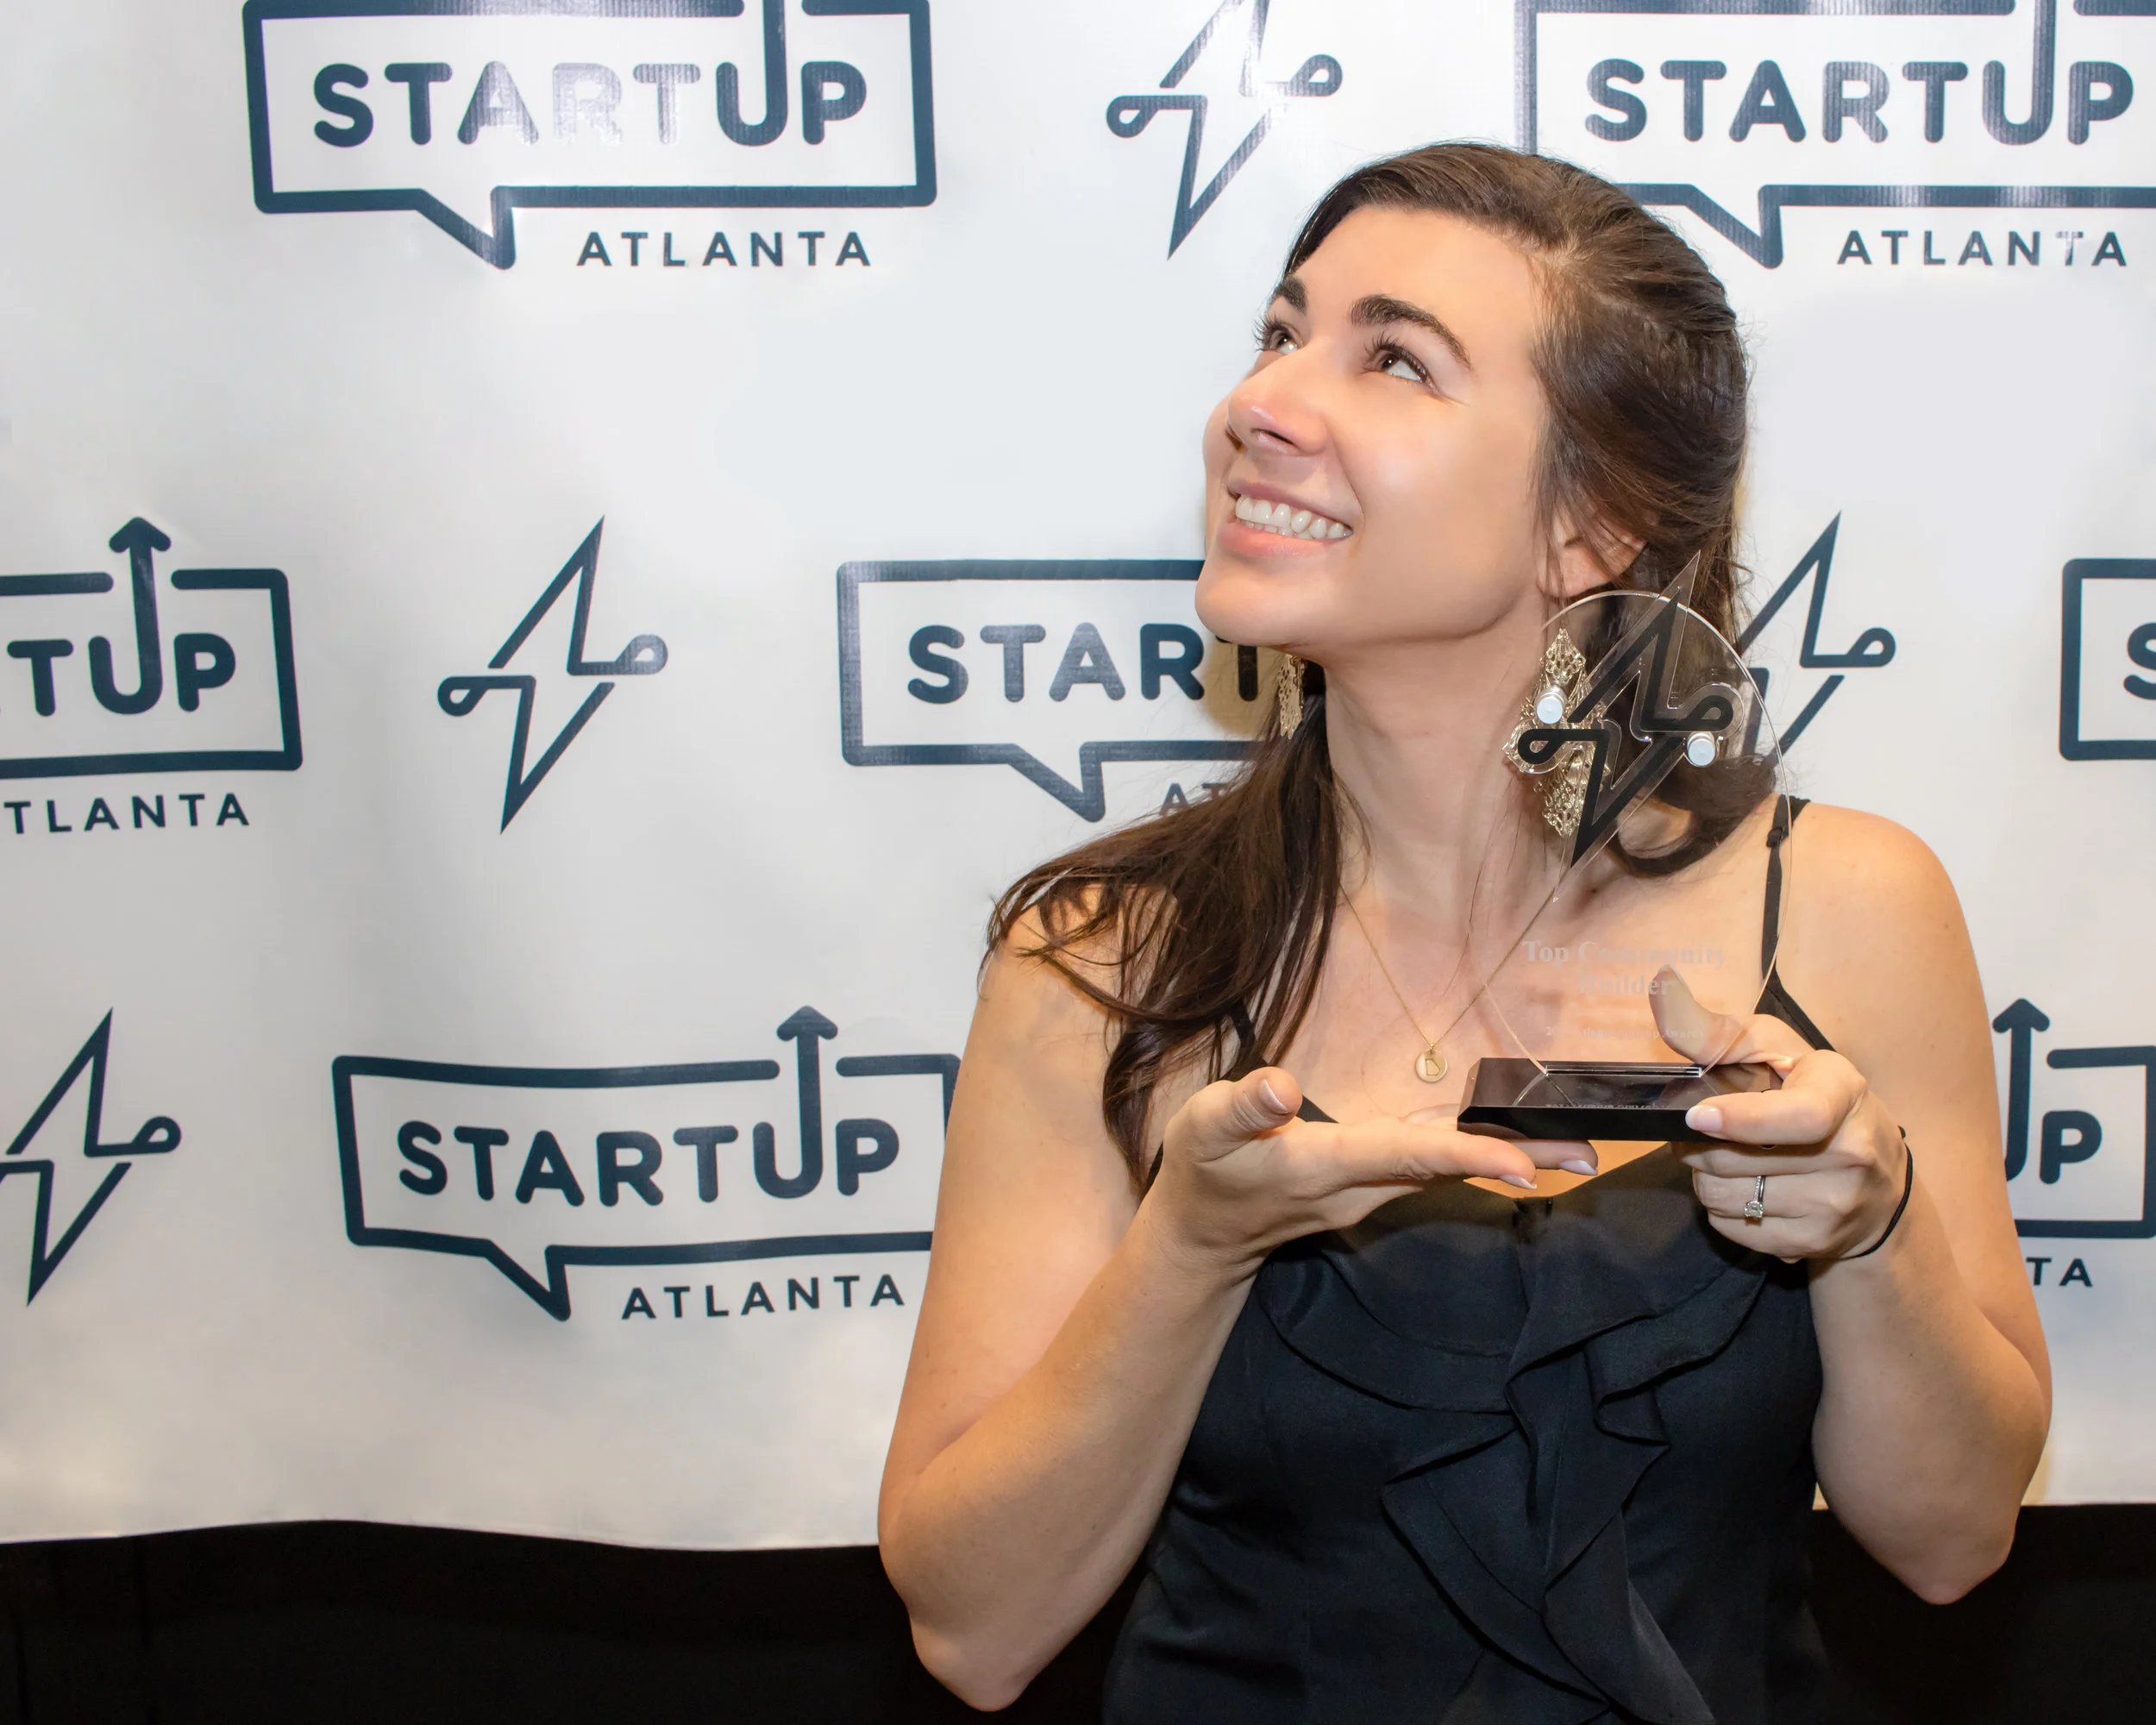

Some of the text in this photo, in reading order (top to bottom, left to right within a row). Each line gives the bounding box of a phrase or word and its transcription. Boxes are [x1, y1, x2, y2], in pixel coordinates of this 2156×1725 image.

[313, 60, 867, 147] STARTUP
[1585, 58, 2134, 146] STARTUP
[577, 231, 871, 267] ATLANTA
[1837, 230, 2128, 267] ATLANTA
[4, 793, 249, 835] TLANTA
[1523, 941, 1570, 969] Top
[397, 1119, 899, 1208] STARTUP
[621, 1274, 905, 1320] ATLANTA
